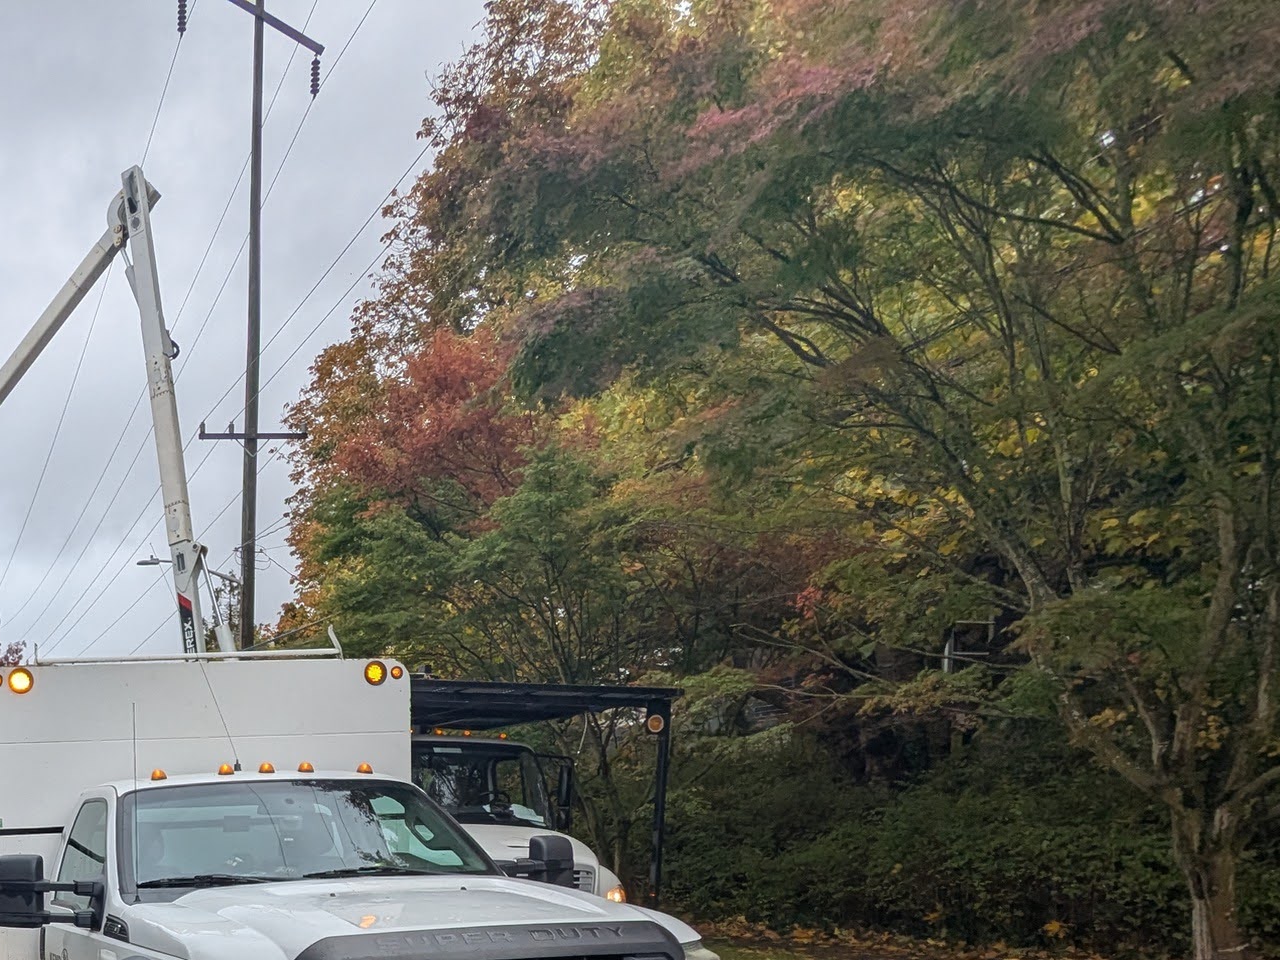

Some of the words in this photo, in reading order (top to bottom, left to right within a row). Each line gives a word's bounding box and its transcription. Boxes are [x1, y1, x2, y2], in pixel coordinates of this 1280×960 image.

[184, 621, 195, 653] EREX
[375, 929, 513, 949] SUPER
[528, 926, 624, 942] DUTY
